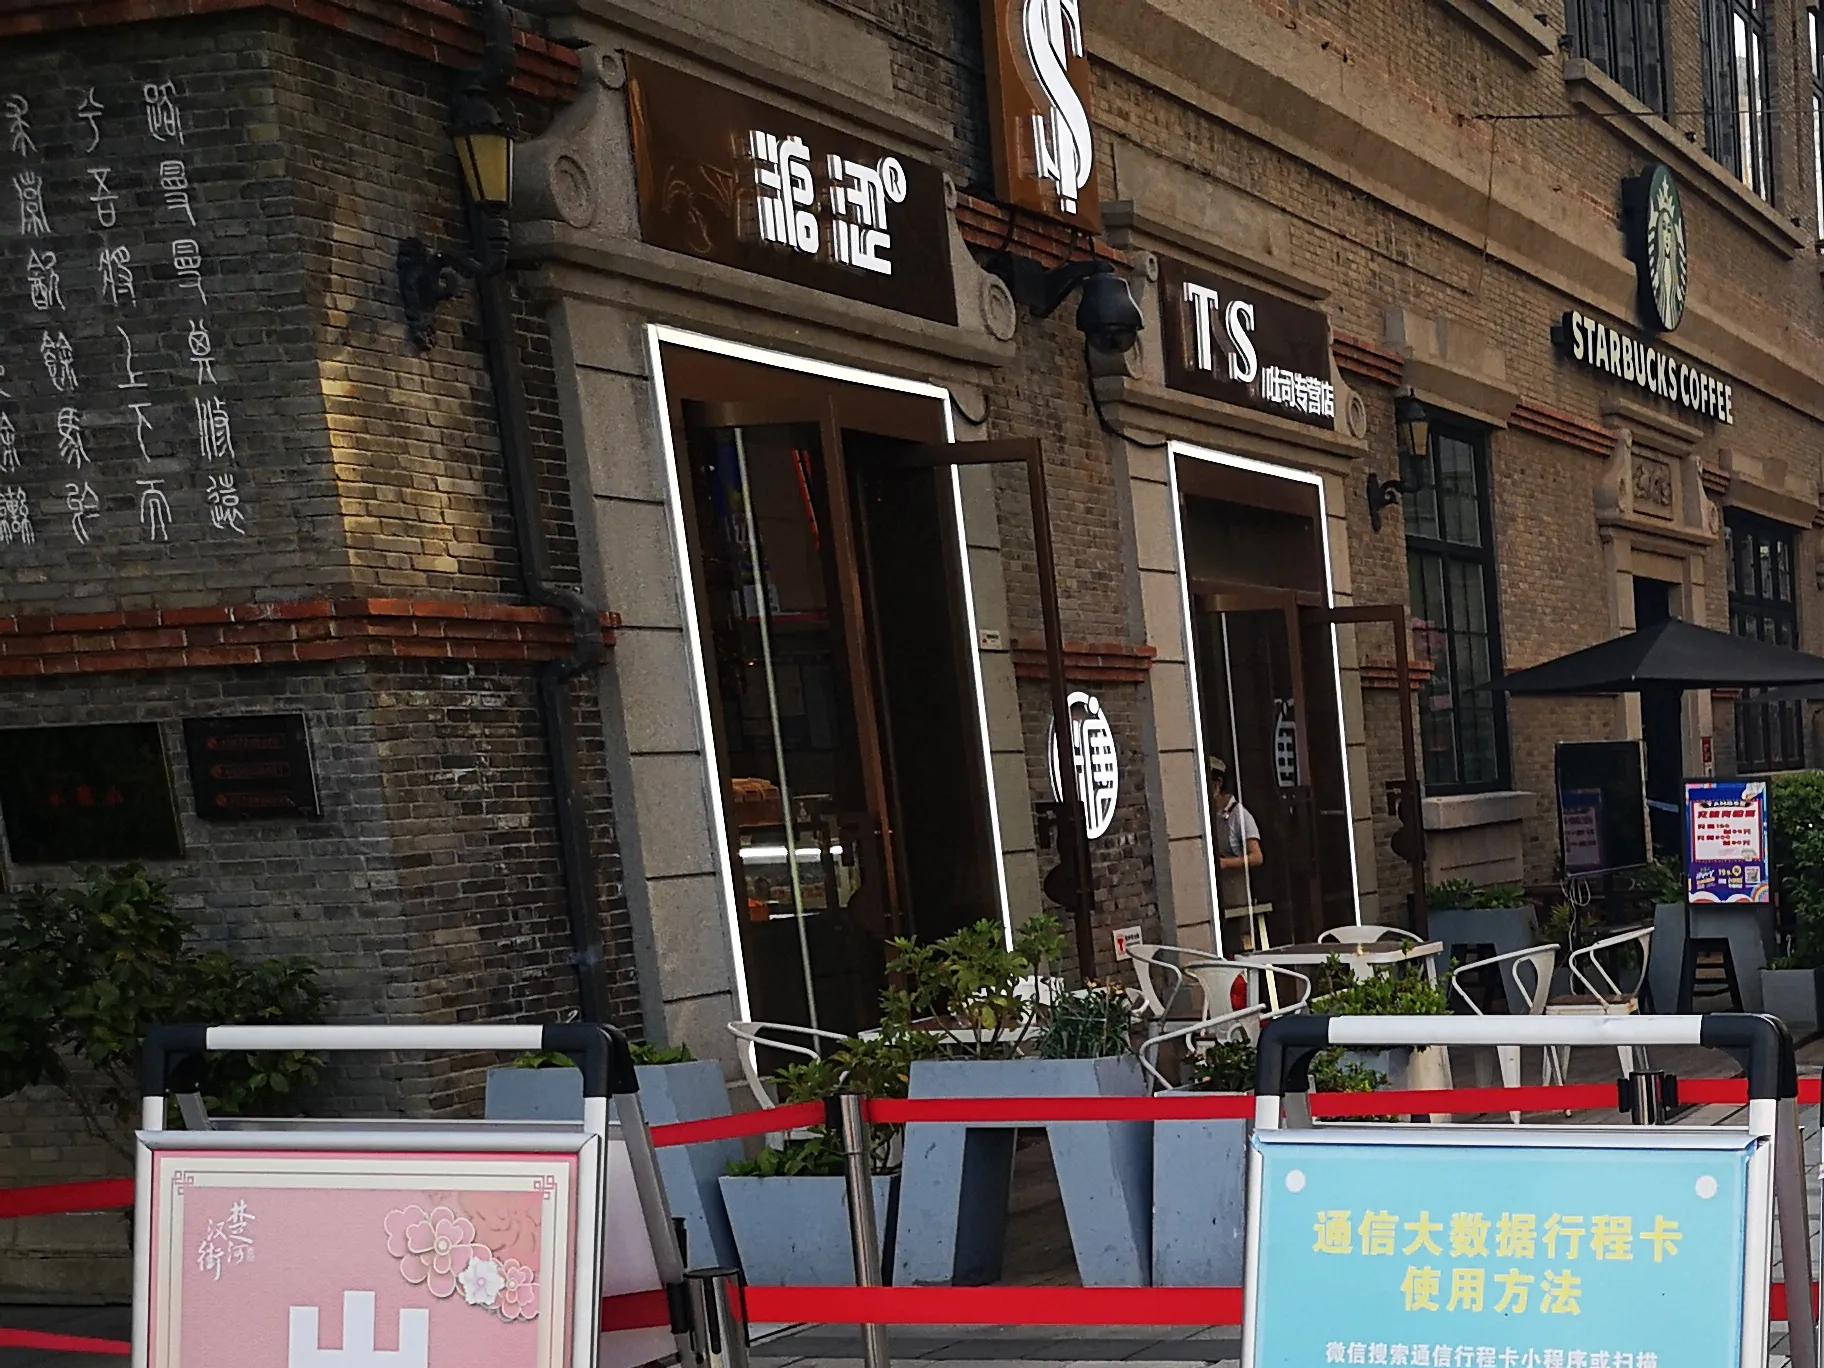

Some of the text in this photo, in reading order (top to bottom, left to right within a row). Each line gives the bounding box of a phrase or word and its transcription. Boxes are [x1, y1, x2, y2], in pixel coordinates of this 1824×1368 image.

[1266, 365, 1335, 418] 吐司专营店
[1572, 311, 1734, 425] STARBUCKS COFFEE
[1312, 1208, 1684, 1264] 通信大数据行程卡
[1399, 1264, 1583, 1316] 使用方法
